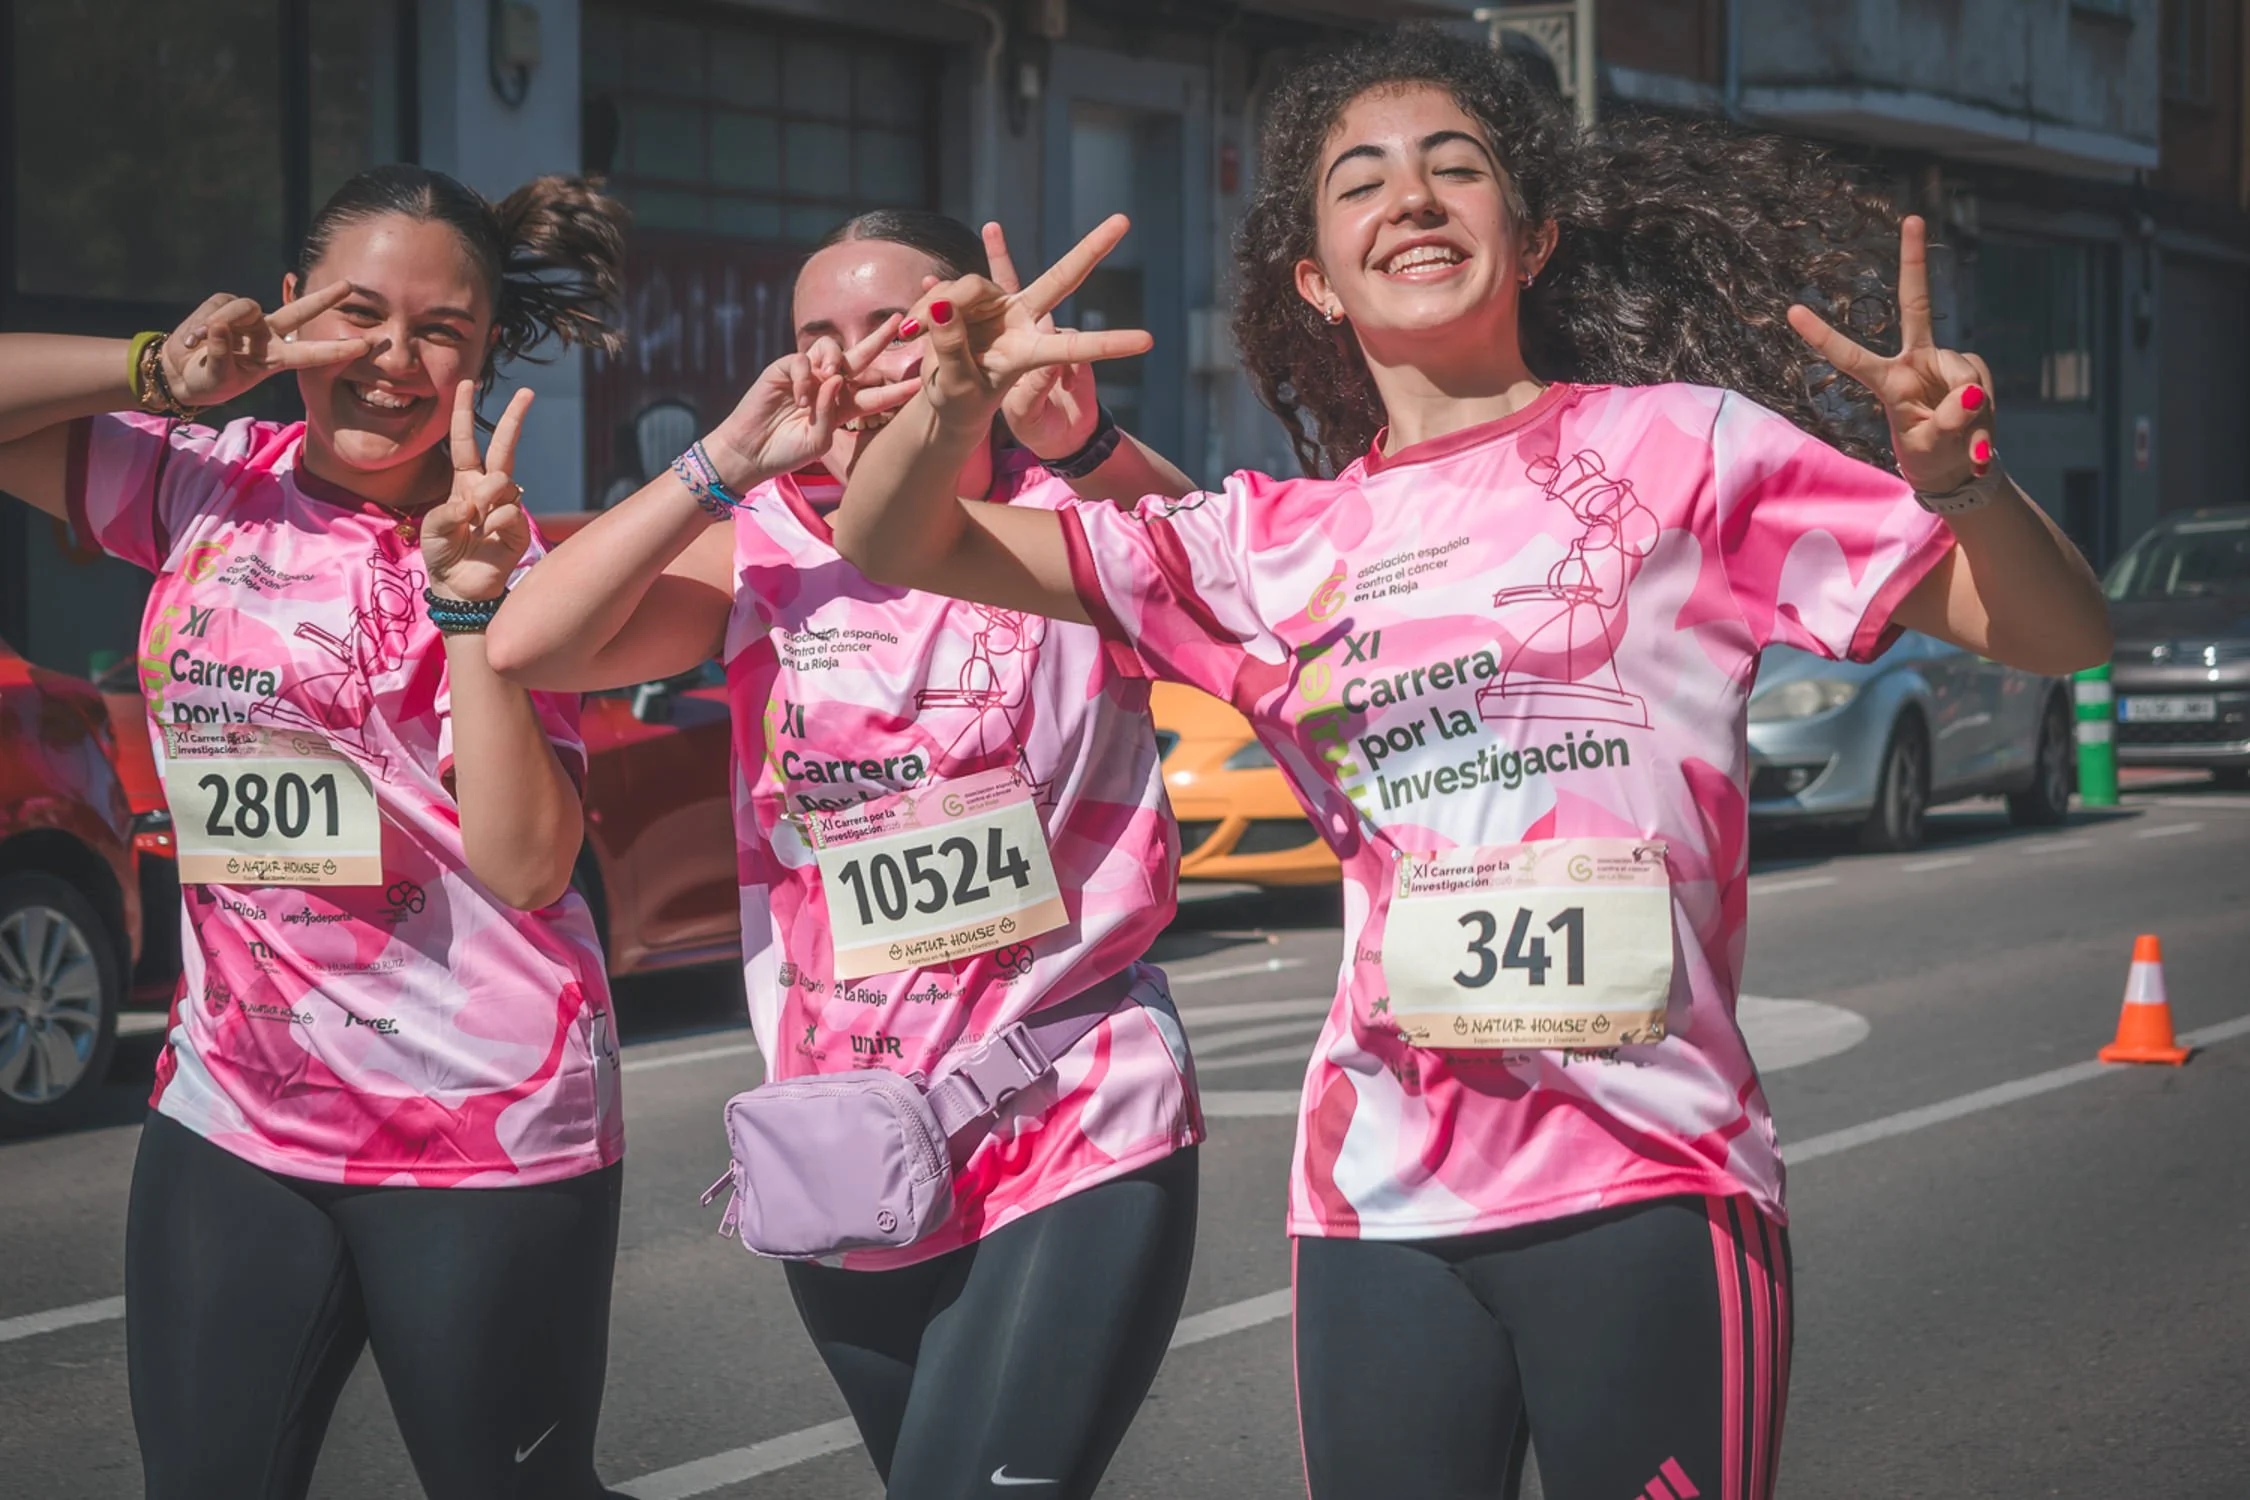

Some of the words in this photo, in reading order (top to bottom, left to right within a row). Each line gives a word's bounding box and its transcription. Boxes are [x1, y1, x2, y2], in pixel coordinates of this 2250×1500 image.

[1357, 552, 1415, 579] asociación
[1418, 536, 1470, 558] española
[1356, 573, 1393, 591] contra
[1395, 568, 1405, 580] el
[1408, 558, 1448, 577] cáncer
[1354, 592, 1369, 602] en
[1372, 588, 1386, 600] La
[1388, 580, 1419, 596] Rioja
[178, 605, 215, 637] XI
[843, 629, 898, 644] española
[783, 643, 815, 657] contra
[818, 643, 827, 653] el
[830, 642, 872, 653] cáncer
[797, 660, 809, 671] La
[811, 657, 839, 671] Rioja
[1340, 629, 1382, 667] XI
[170, 648, 275, 697] Carrera
[1341, 649, 1500, 714] Carrera
[781, 700, 805, 738] XI
[176, 732, 188, 743] XI
[190, 734, 226, 743] Carrera
[1358, 718, 1427, 772] por
[1429, 705, 1478, 741] la
[782, 750, 926, 784] Carrera
[1375, 729, 1630, 811] Investigación
[198, 772, 340, 838] 2801
[820, 818, 833, 832] XI
[835, 817, 867, 829] Carrera
[869, 812, 884, 824] por
[885, 809, 895, 818] la
[825, 825, 883, 843] investigación
[838, 828, 1030, 926] 10524
[1411, 878, 1489, 892] investigación
[1413, 864, 1427, 879] XI
[1430, 866, 1474, 877] Carrera
[1477, 862, 1496, 874] por
[1498, 860, 1510, 870] la
[905, 937, 947, 956] NATUR
[950, 924, 995, 946] HOUSE
[1453, 907, 1584, 988] 341
[844, 985, 855, 1001] La
[858, 988, 888, 1007] Rioja
[1472, 1018, 1526, 1033] NATUR
[1530, 1018, 1588, 1033] HOUSE
